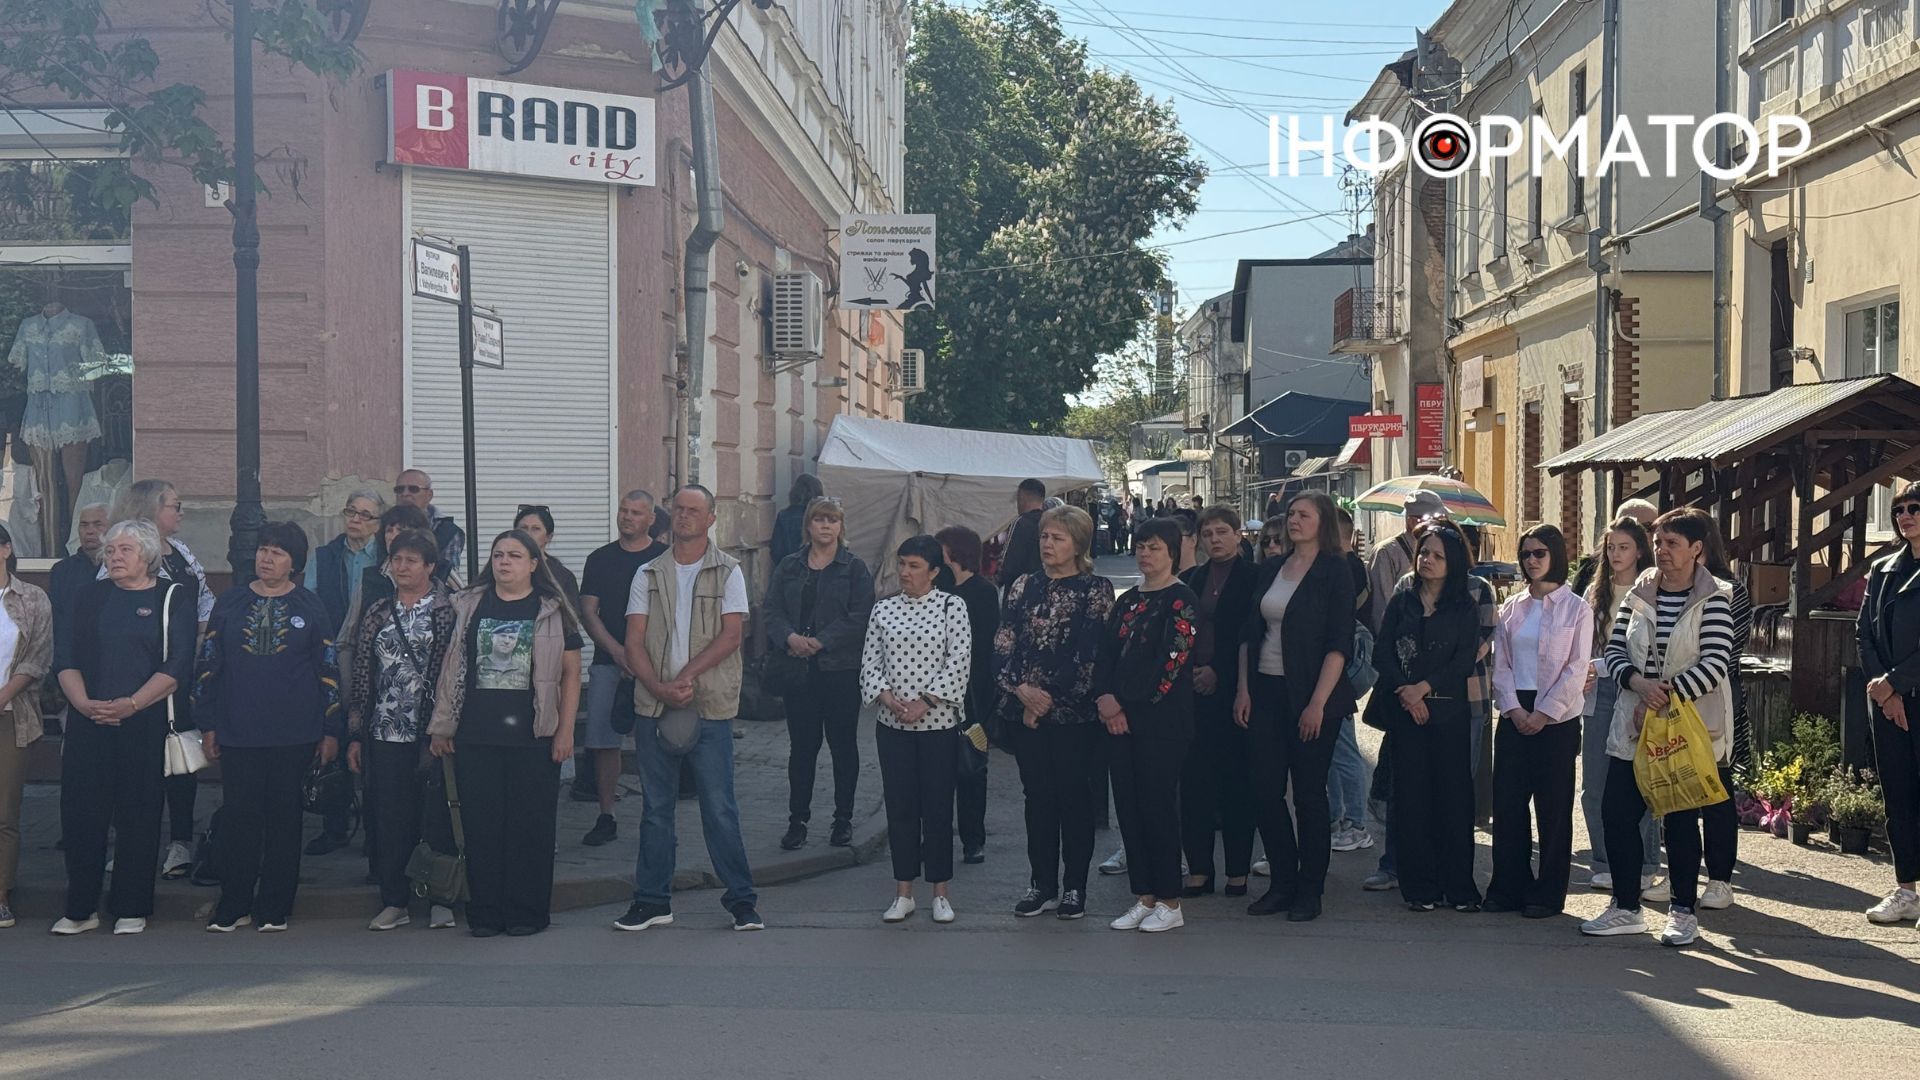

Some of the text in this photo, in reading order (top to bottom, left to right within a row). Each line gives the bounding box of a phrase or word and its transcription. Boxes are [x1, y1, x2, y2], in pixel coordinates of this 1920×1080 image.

[416, 84, 637, 151] BRAND
[569, 151, 644, 180] city
[845, 219, 932, 237] Попелюшка
